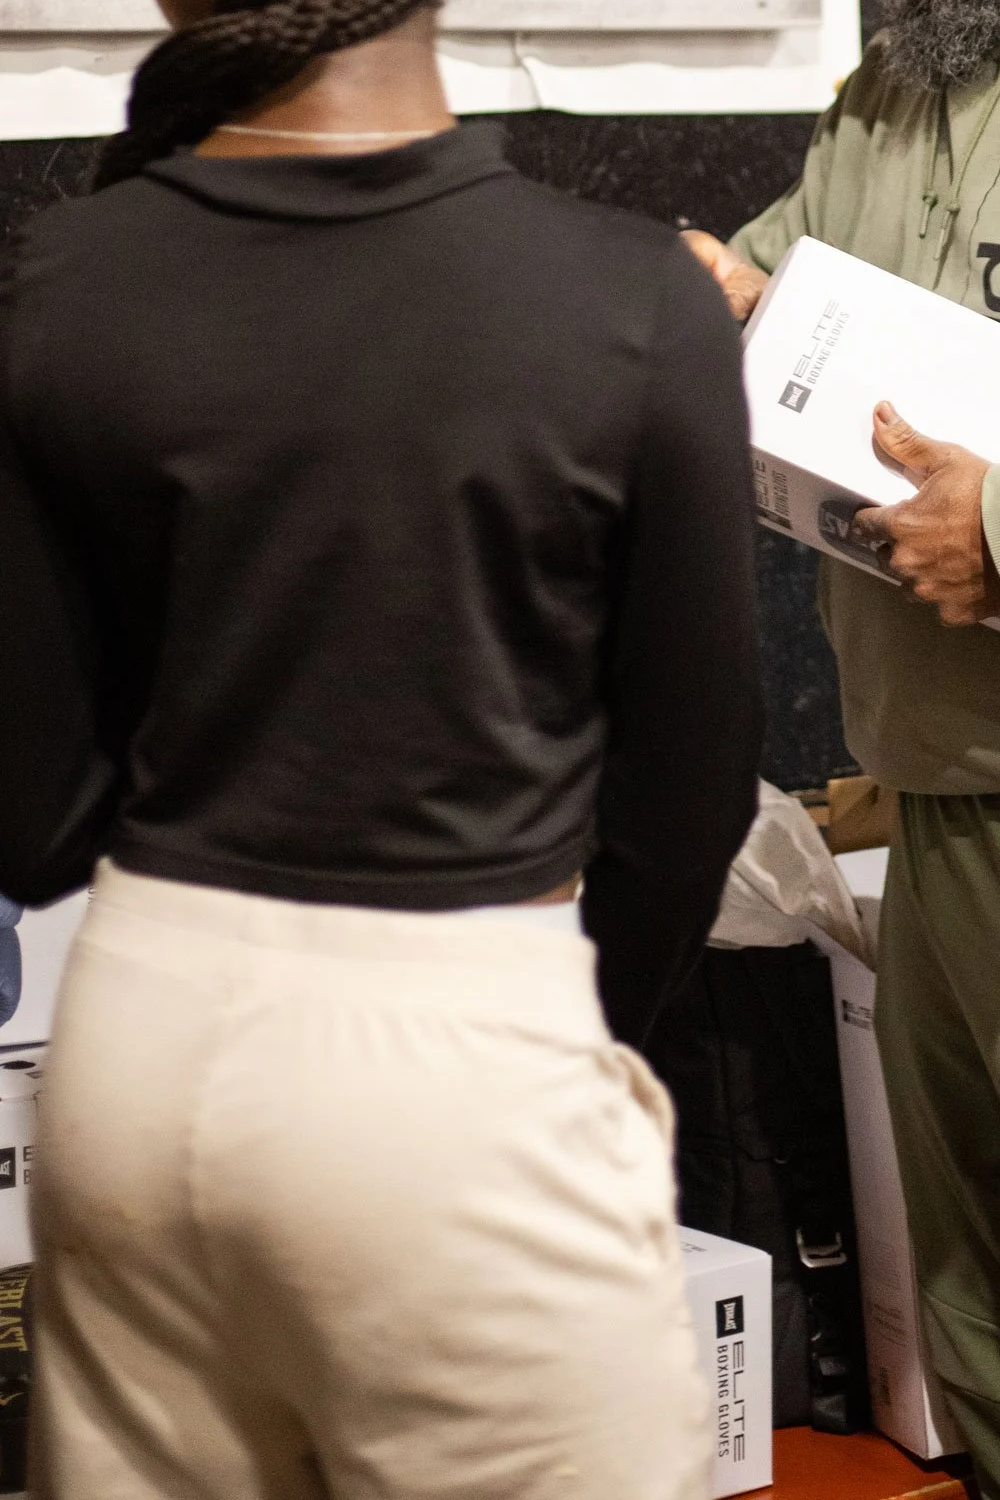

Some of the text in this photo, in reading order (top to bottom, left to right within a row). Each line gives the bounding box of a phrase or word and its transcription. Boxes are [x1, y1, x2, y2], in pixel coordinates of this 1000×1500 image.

[793, 299, 840, 378] ELITE
[806, 347, 832, 385] BOXING
[716, 1344, 730, 1458] BOXING GLOVES
[732, 1340, 746, 1463] ELITE
